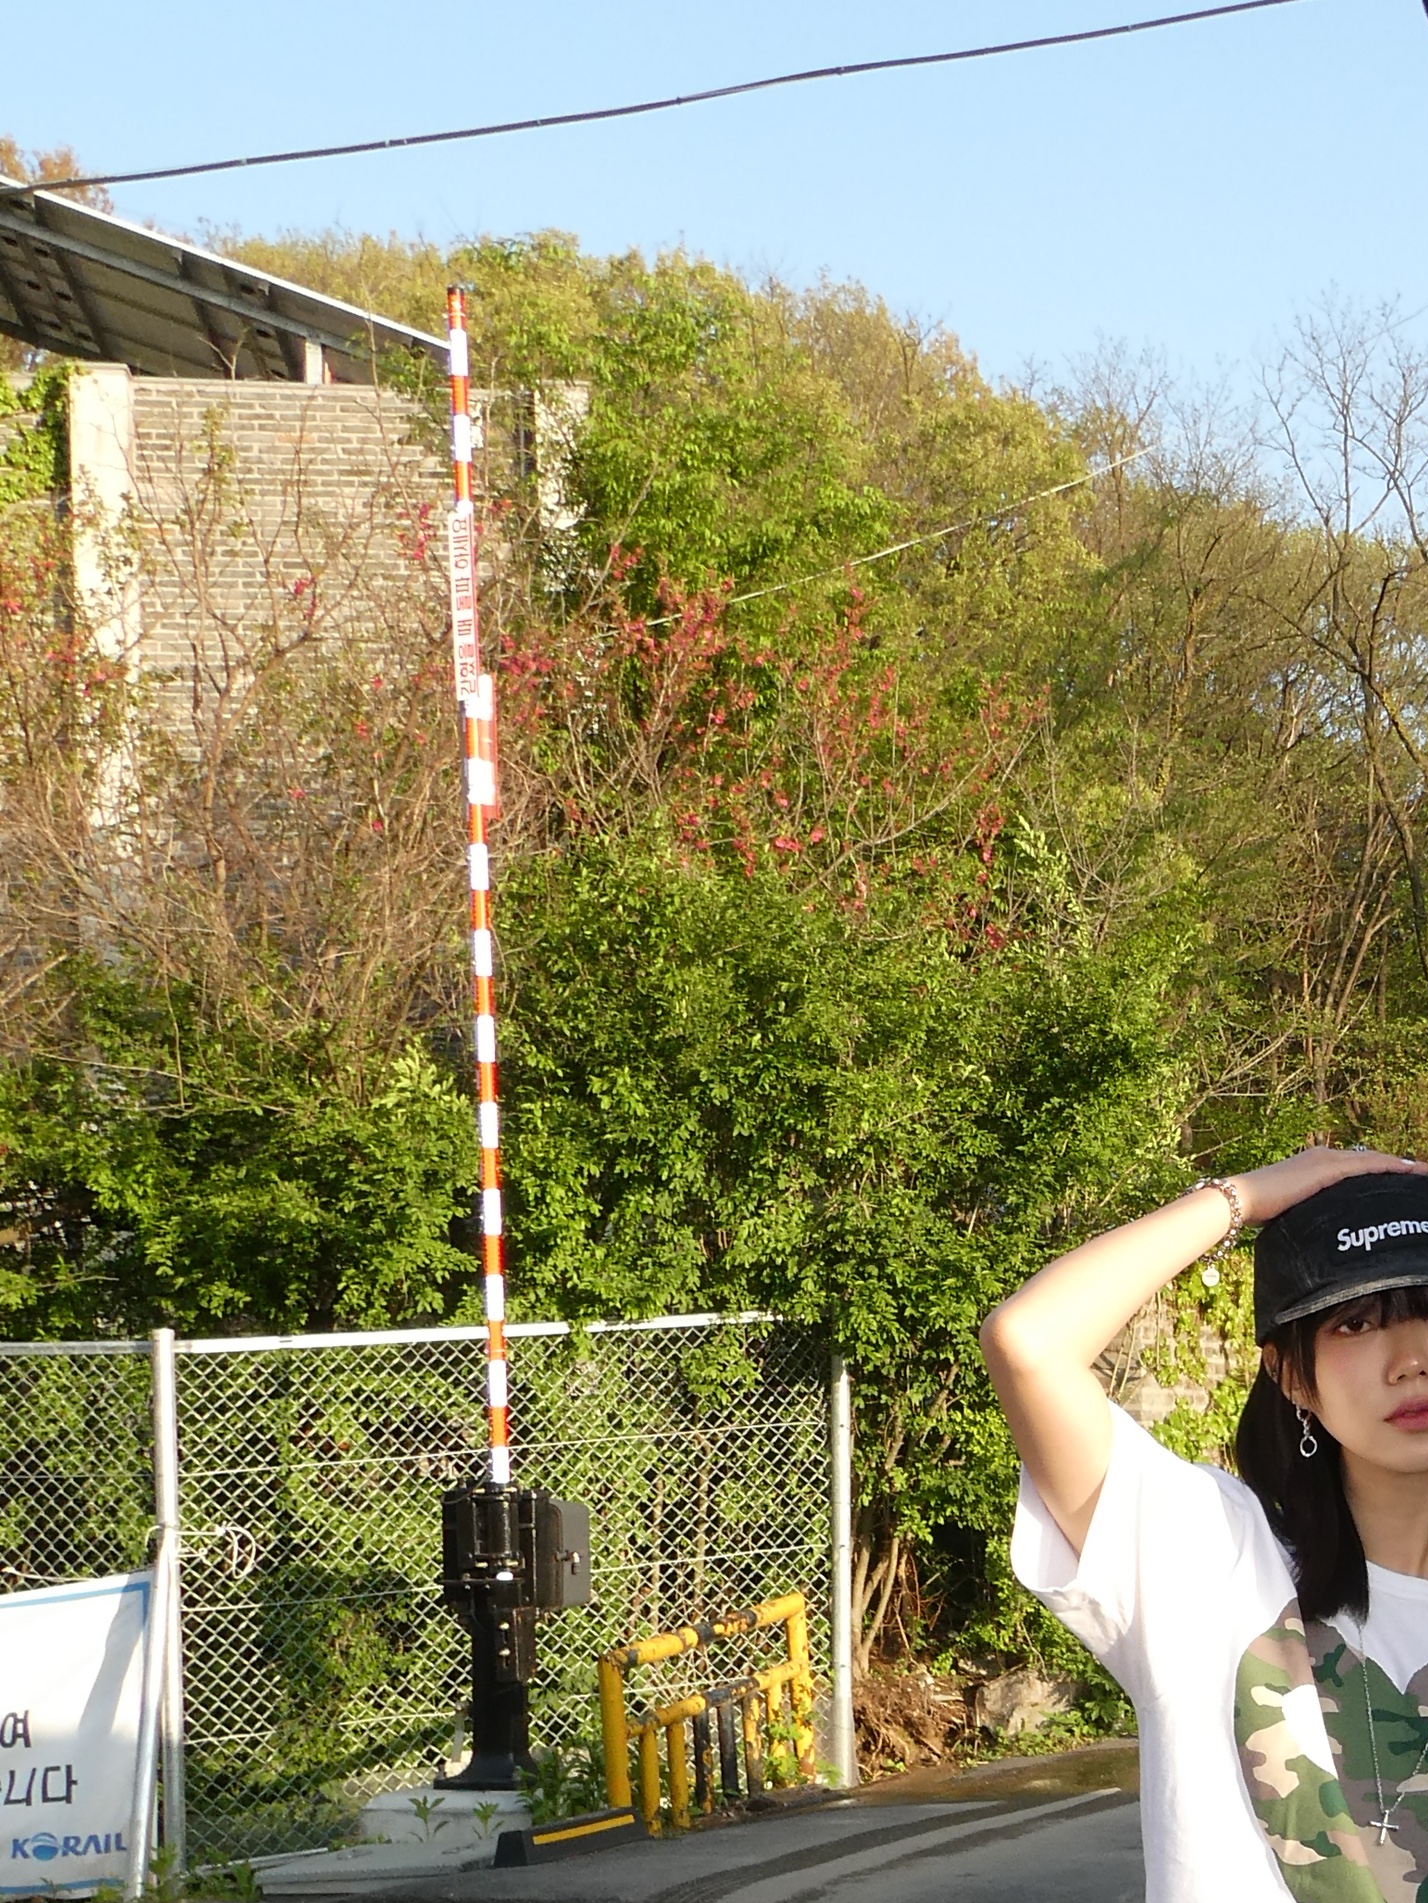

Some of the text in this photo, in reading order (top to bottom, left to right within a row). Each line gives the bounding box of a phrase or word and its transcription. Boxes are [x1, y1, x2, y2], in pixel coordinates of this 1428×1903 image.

[457, 618, 473, 637] 때
[0, 1764, 78, 1806] 니다
[11, 1832, 127, 1861] KORAIL
